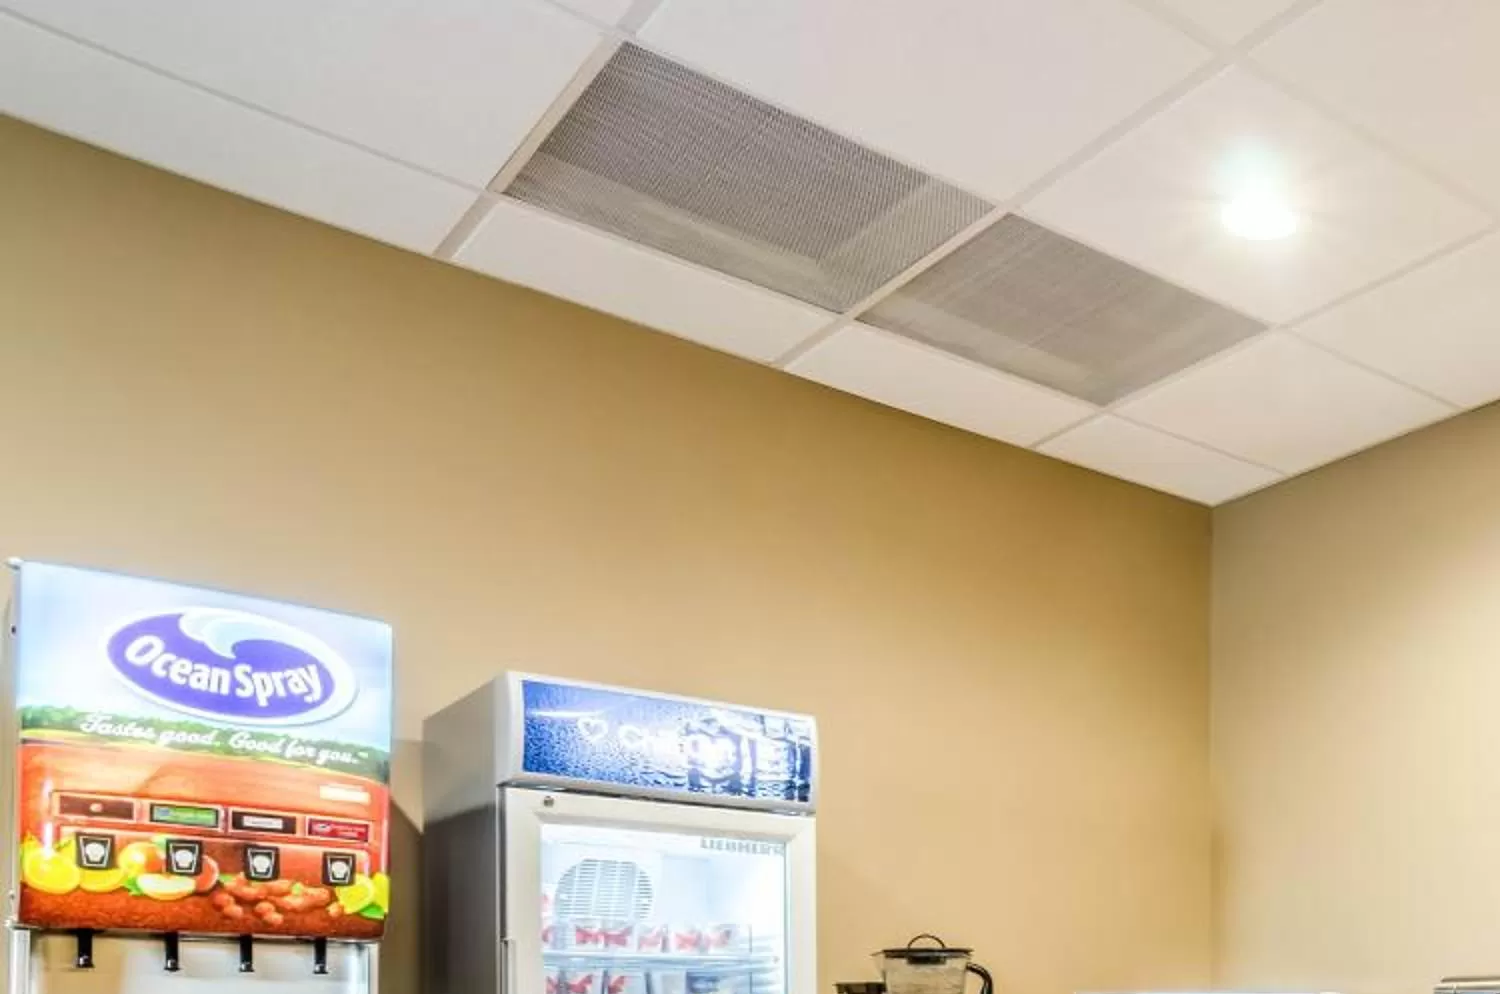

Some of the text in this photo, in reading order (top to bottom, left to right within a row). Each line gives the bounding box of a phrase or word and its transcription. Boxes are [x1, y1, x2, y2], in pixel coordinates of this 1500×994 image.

[124, 634, 323, 707] Ocean Spray
[229, 731, 288, 753] Good
[283, 739, 316, 758] for
